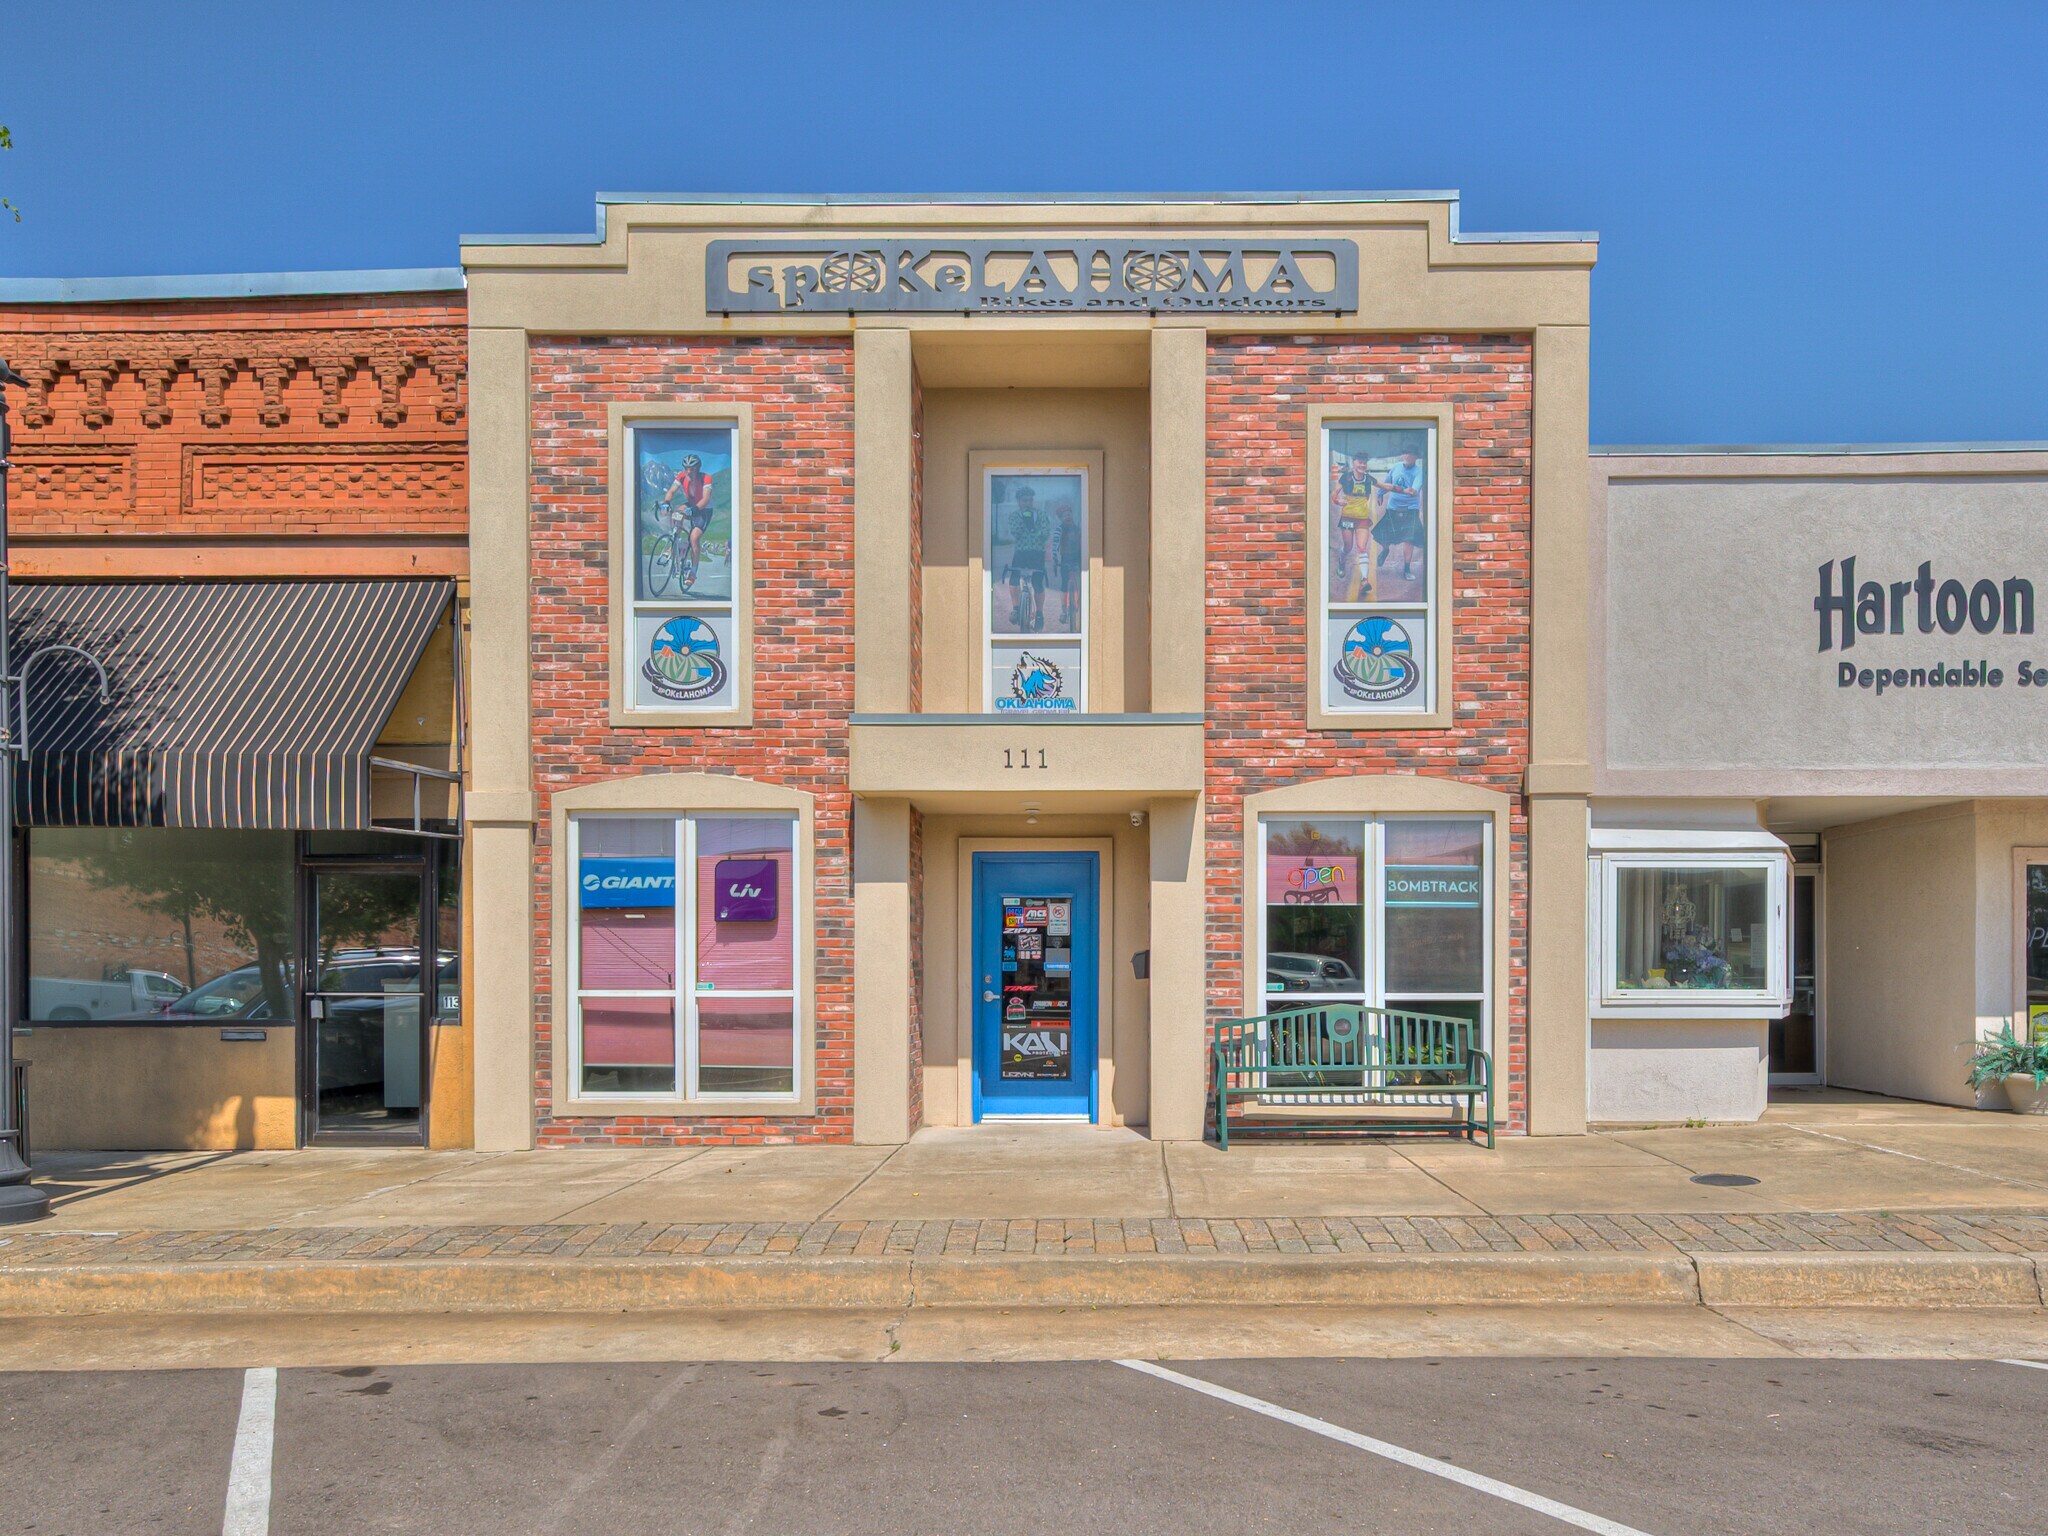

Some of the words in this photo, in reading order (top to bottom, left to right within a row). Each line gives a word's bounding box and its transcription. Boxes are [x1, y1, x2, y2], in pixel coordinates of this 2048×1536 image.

[979, 296, 1074, 308] Bikes
[1086, 296, 1149, 308] and
[1162, 296, 1327, 308] Outdoors
[1813, 555, 2034, 653] Hartoon
[1838, 660, 2004, 696] Dependable
[996, 697, 1076, 710] OKLAHOMA
[1004, 748, 1048, 769] 111
[602, 876, 675, 889] GIANT
[1287, 865, 1346, 890] open
[1387, 880, 1479, 893] BOMBTRACK
